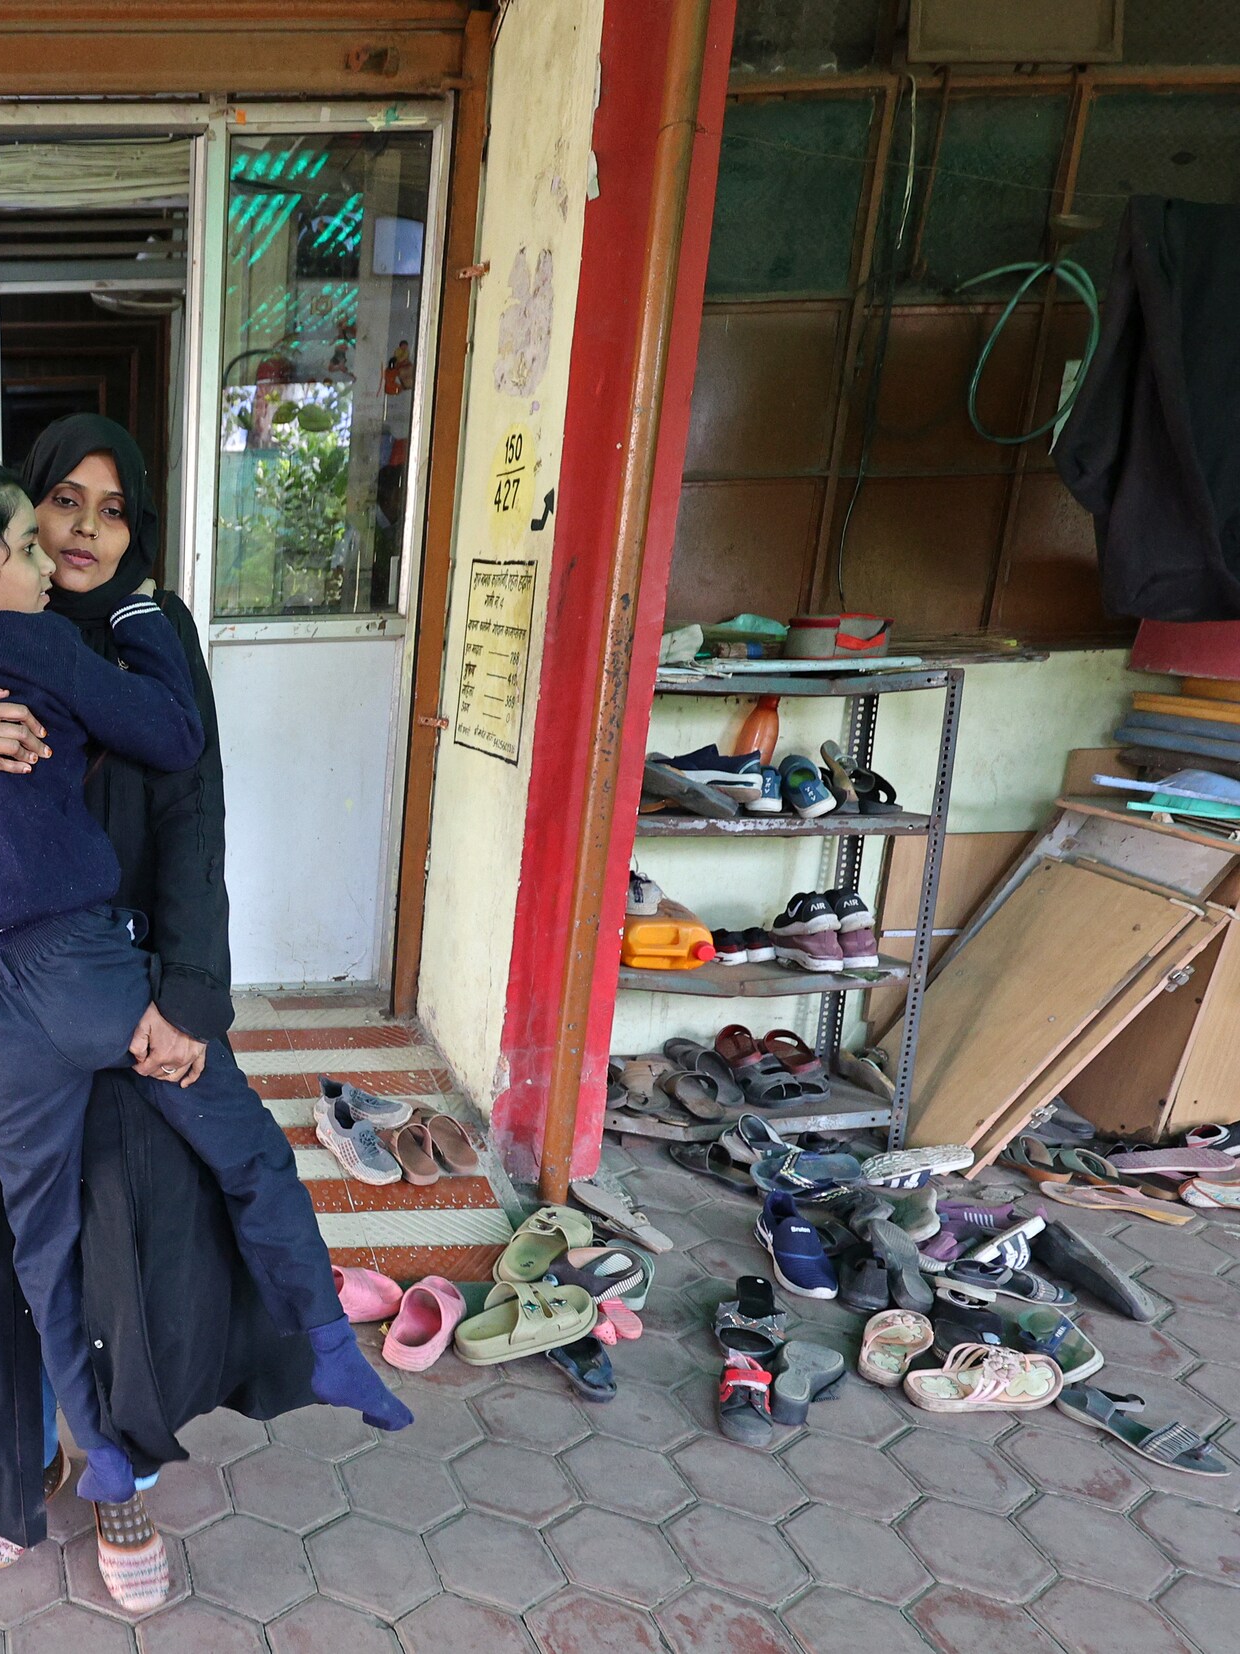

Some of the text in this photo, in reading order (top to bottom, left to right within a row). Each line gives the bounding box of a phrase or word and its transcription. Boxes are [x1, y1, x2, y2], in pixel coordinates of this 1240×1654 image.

[504, 433, 523, 464] 150
[494, 478, 521, 513] 427
[810, 902, 826, 912] AIR
[843, 899, 859, 908] AIR
